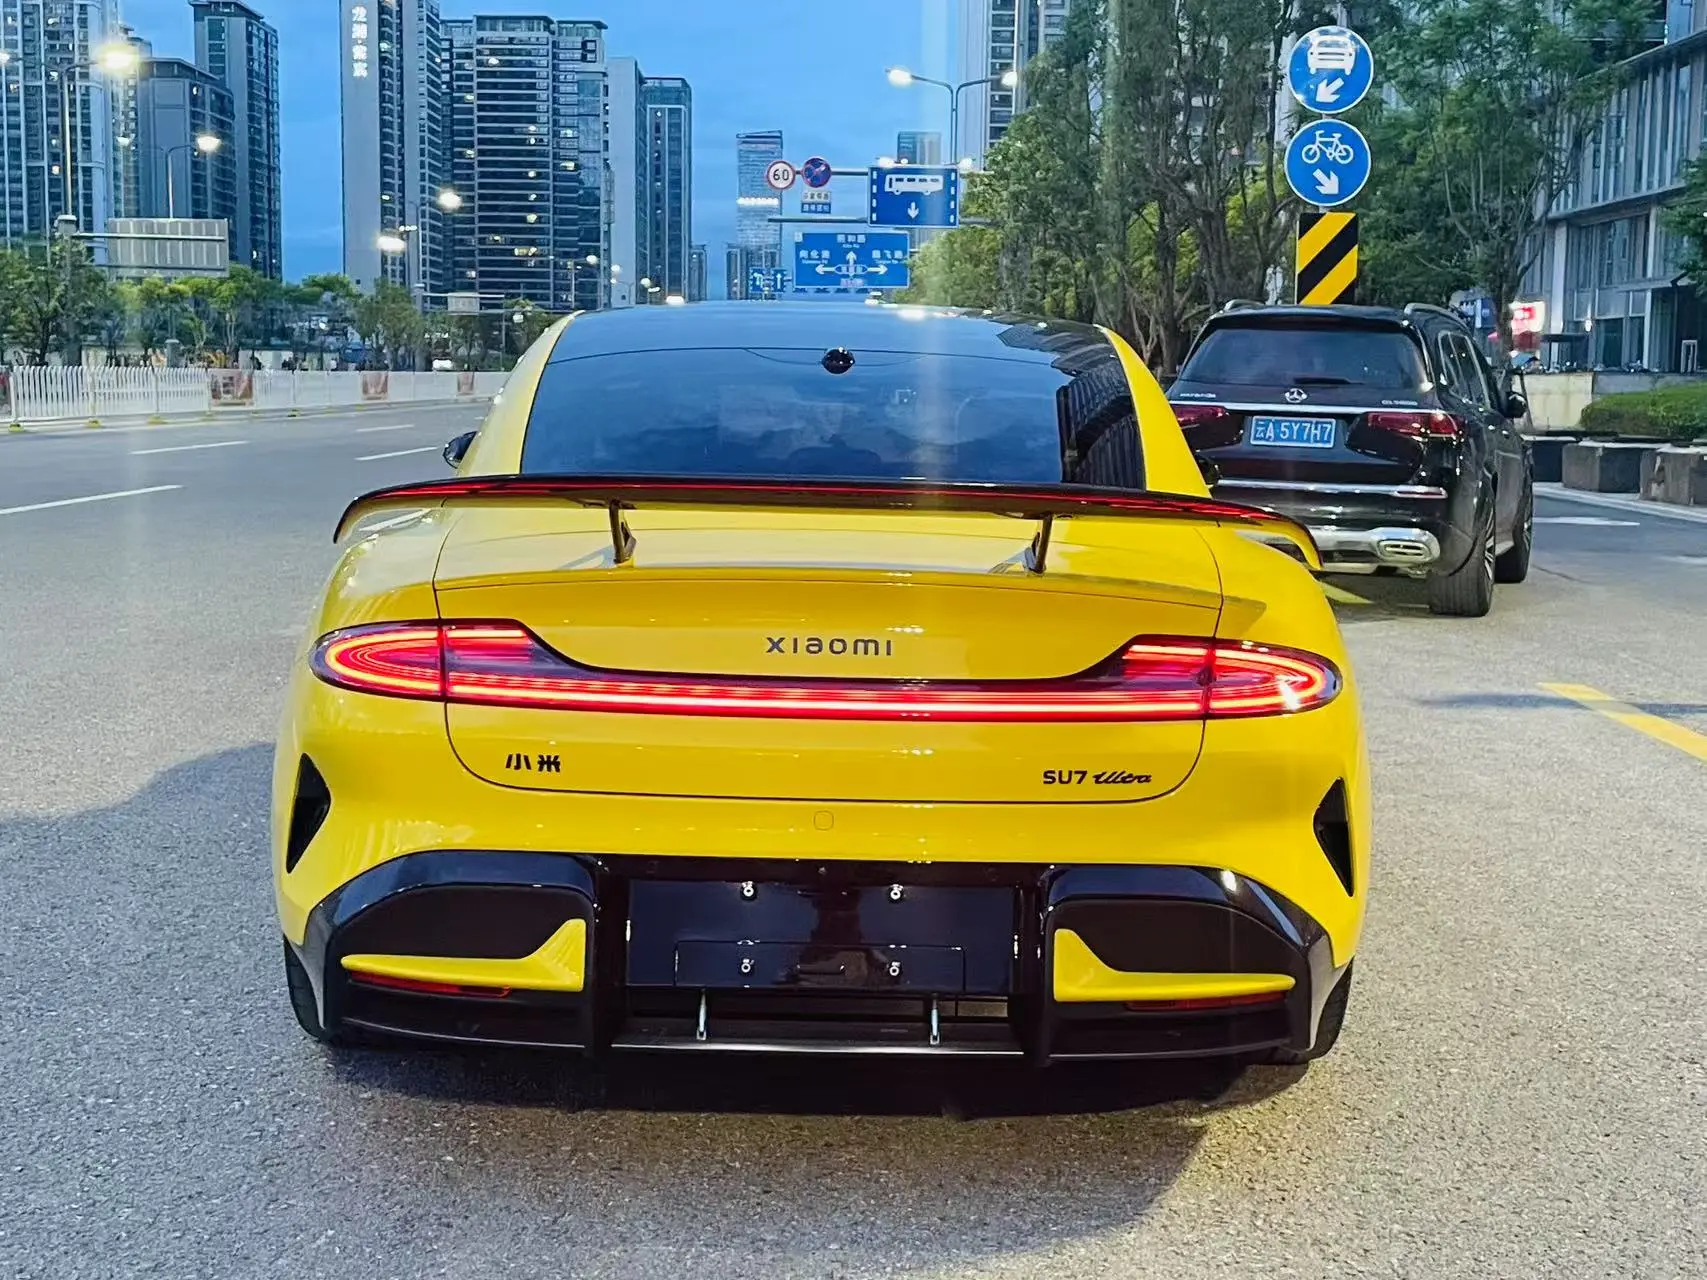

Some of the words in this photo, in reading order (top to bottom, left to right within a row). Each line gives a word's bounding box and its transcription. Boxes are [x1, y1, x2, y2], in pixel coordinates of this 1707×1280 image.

[773, 169, 790, 181] 60
[505, 753, 561, 773] 小米
[1043, 770, 1088, 785] SU7
[1092, 770, 1152, 785] Ultra
